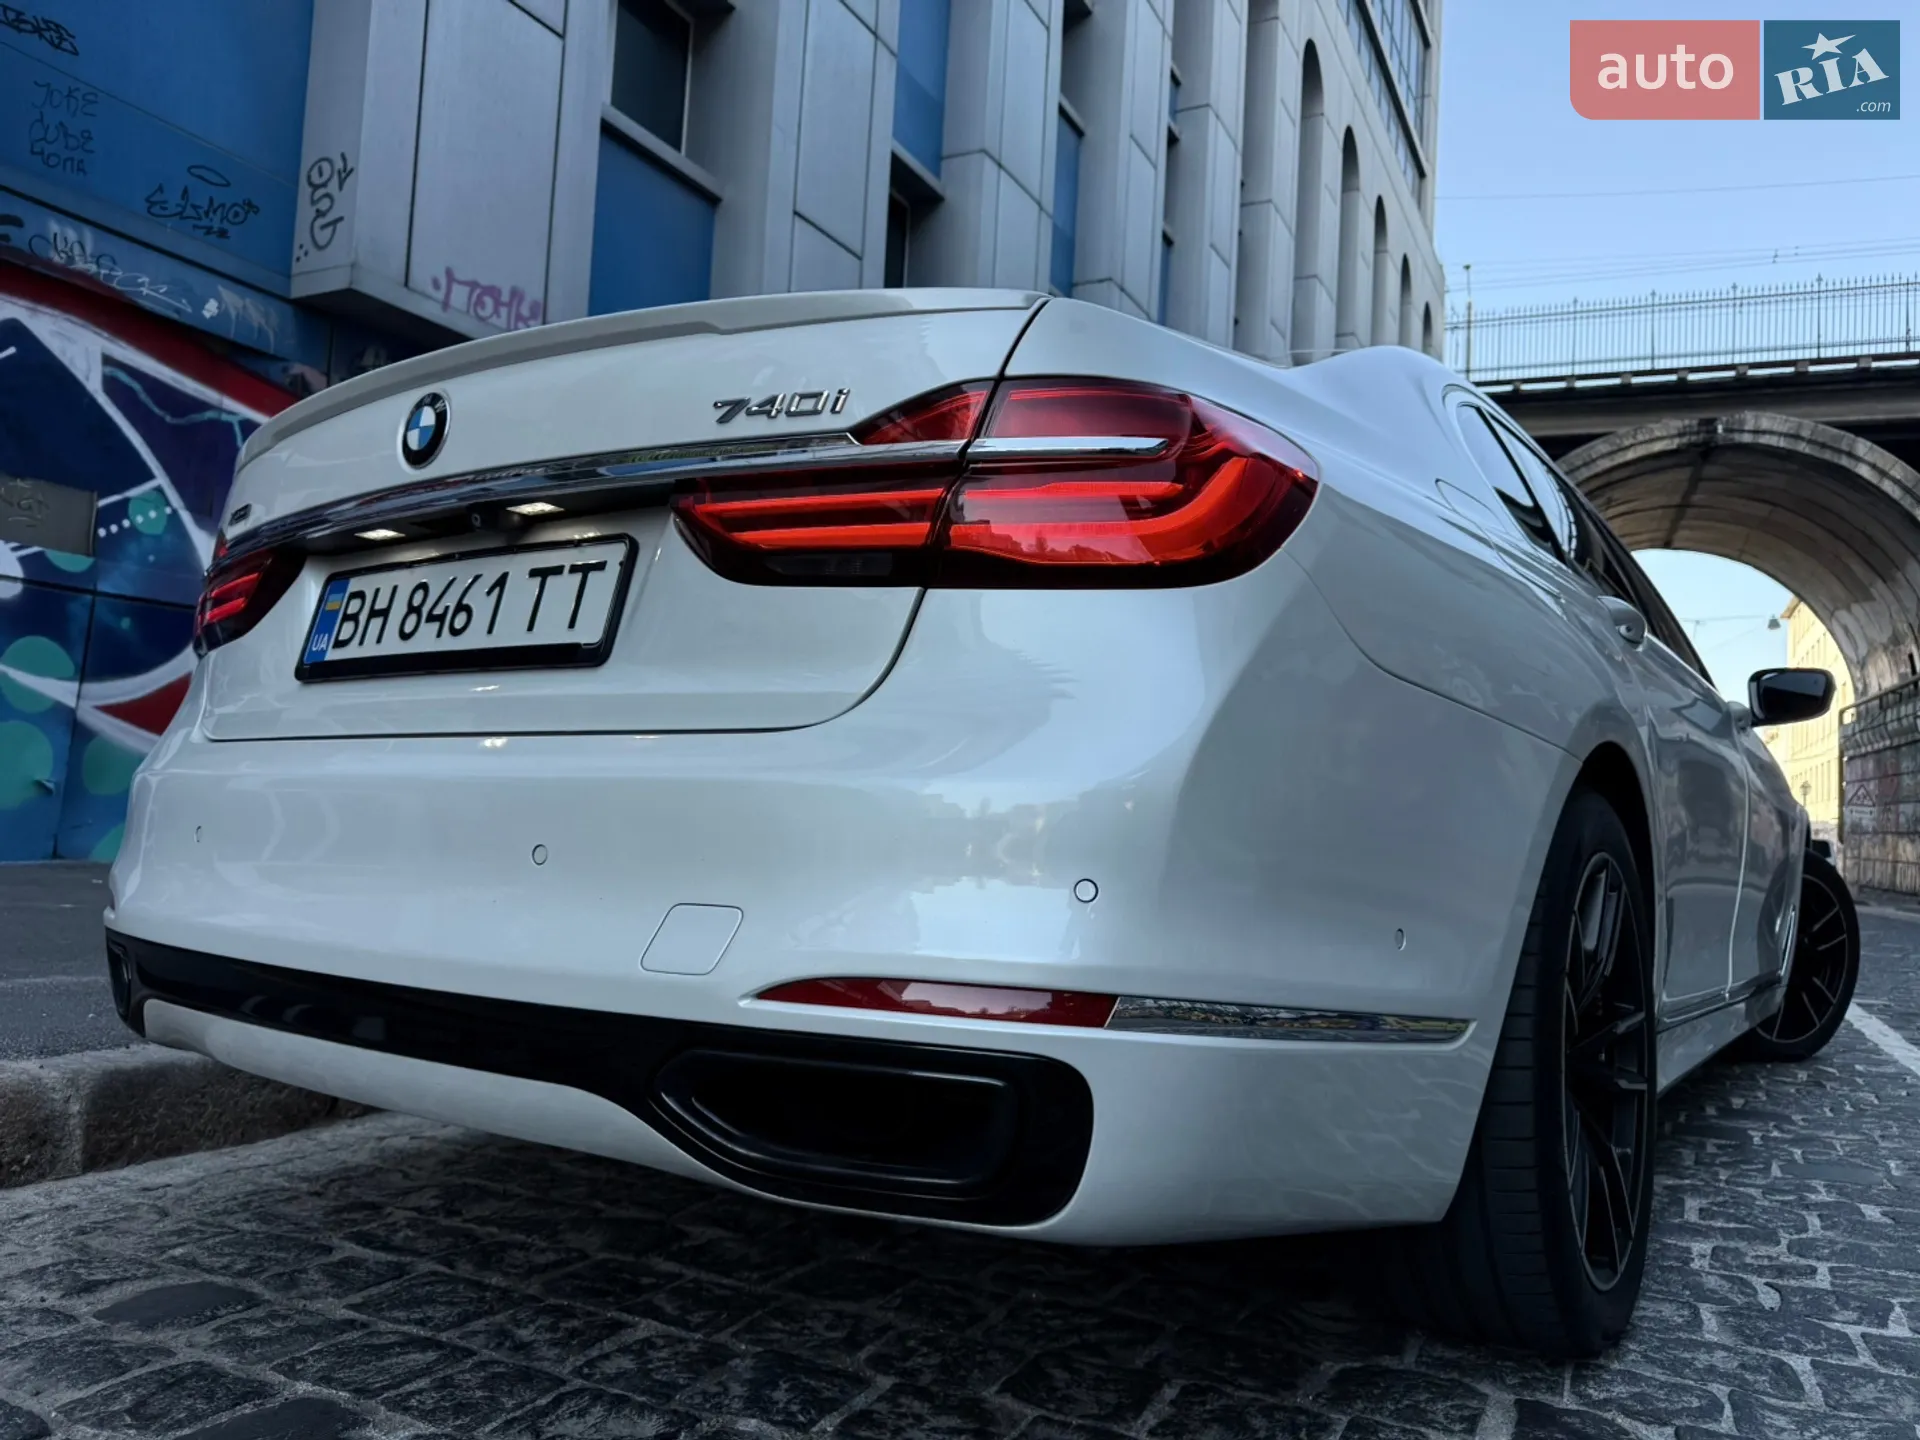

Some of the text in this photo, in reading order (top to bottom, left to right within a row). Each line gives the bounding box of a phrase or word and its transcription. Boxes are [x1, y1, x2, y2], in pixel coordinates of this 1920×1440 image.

[713, 388, 850, 423] 740i
[332, 560, 607, 649] BH 8461 TT
[311, 633, 329, 651] UA
